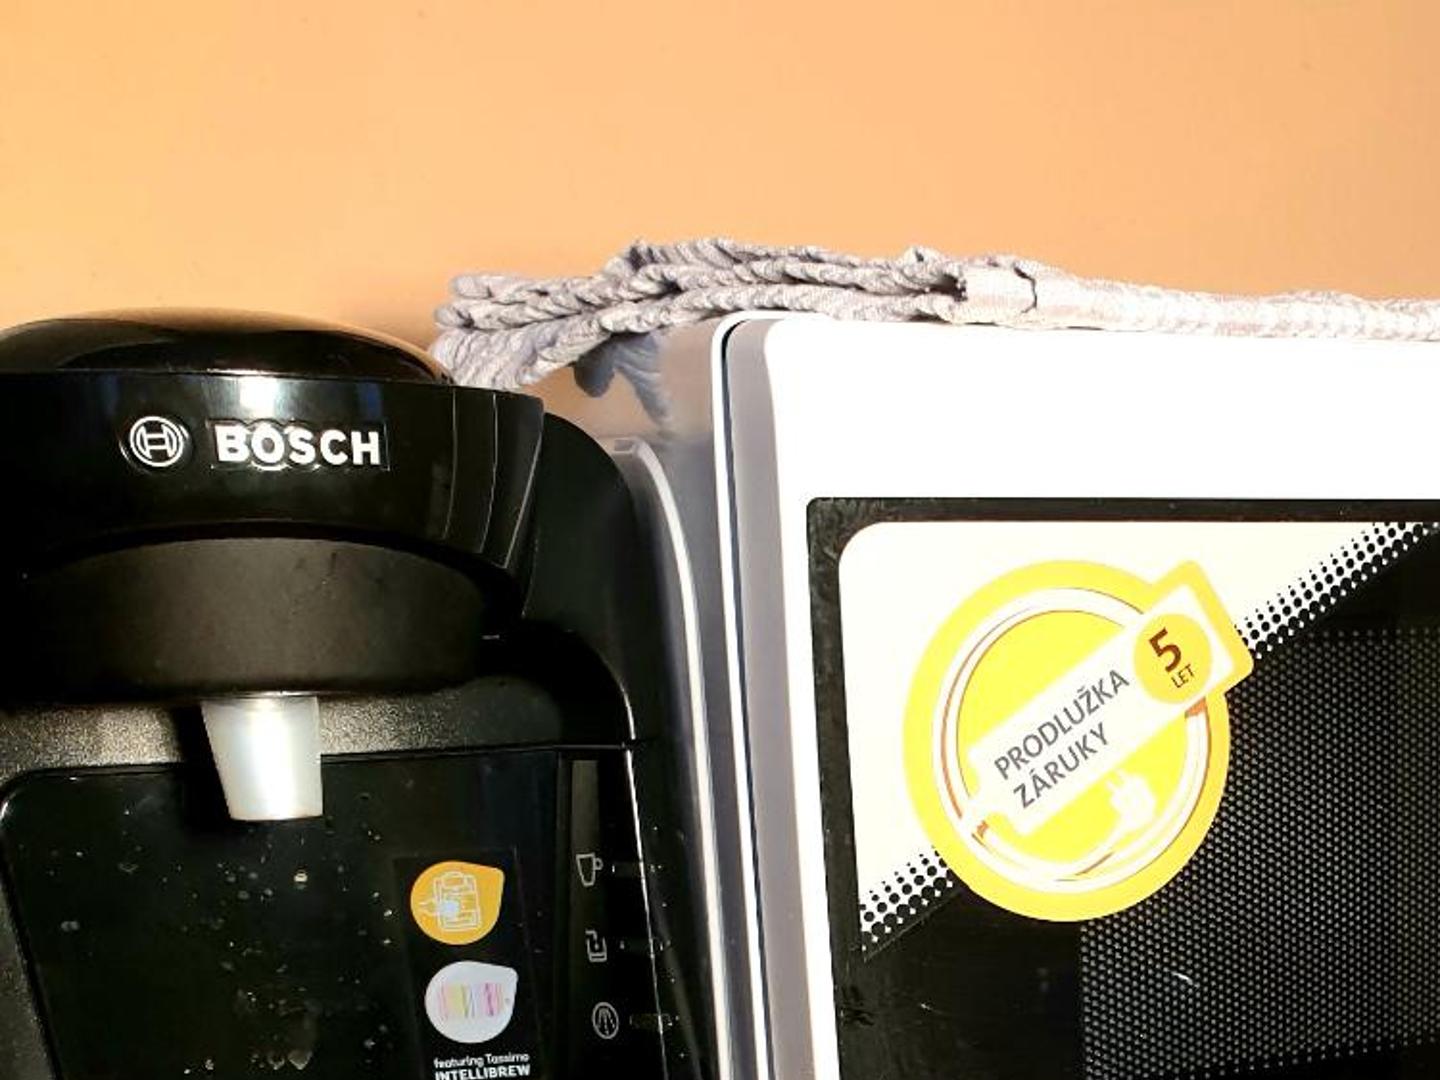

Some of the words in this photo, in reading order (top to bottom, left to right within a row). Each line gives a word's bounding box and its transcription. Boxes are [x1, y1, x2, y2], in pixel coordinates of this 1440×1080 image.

[214, 423, 381, 466] BOSCH
[1148, 627, 1182, 673] 5
[1171, 664, 1197, 689] LET
[993, 669, 1131, 781] PRODLUŽKA
[1013, 723, 1110, 809] ZÁRUKY
[433, 1055, 485, 1068] featuring
[485, 1051, 530, 1065] Tassimo
